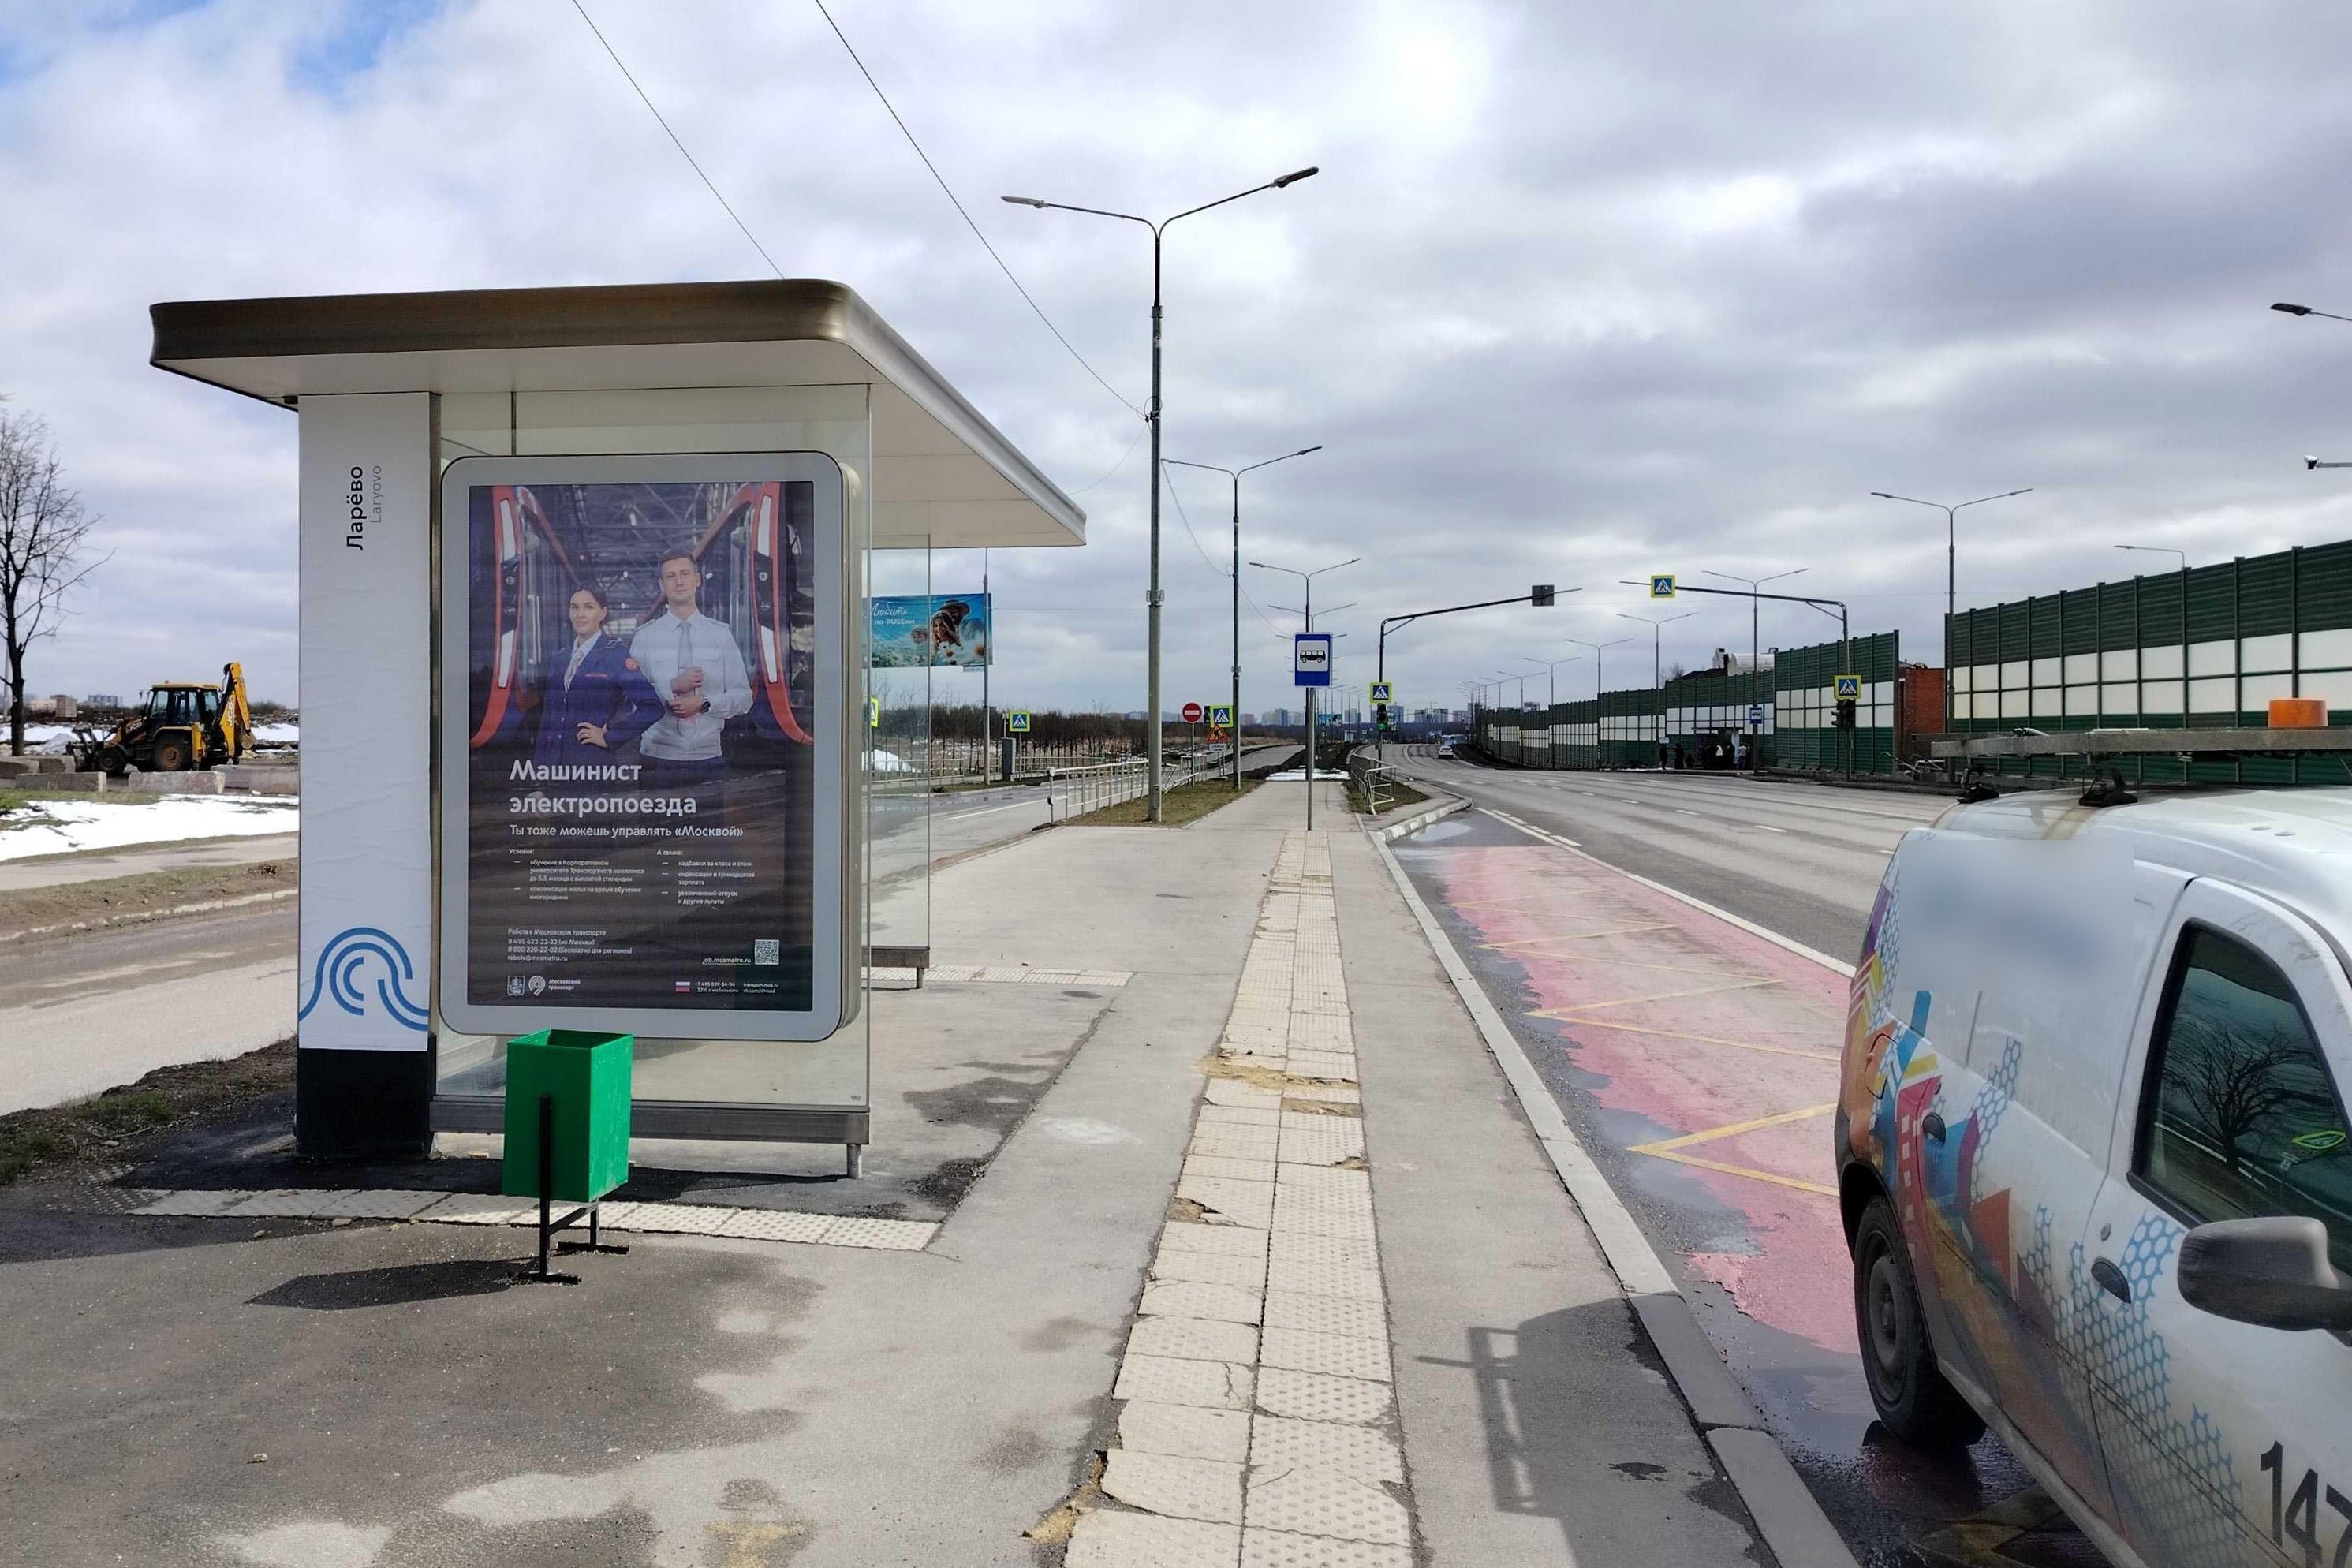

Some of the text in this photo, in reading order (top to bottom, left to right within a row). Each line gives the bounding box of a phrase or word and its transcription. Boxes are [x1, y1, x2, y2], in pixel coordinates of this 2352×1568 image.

[370, 465, 384, 523] Laryovo
[346, 466, 367, 551] Ларёво
[509, 760, 643, 781] Машинист
[510, 797, 696, 817] электропоезда
[510, 825, 743, 838] Ты тоже можешь управлять «Москвой»
